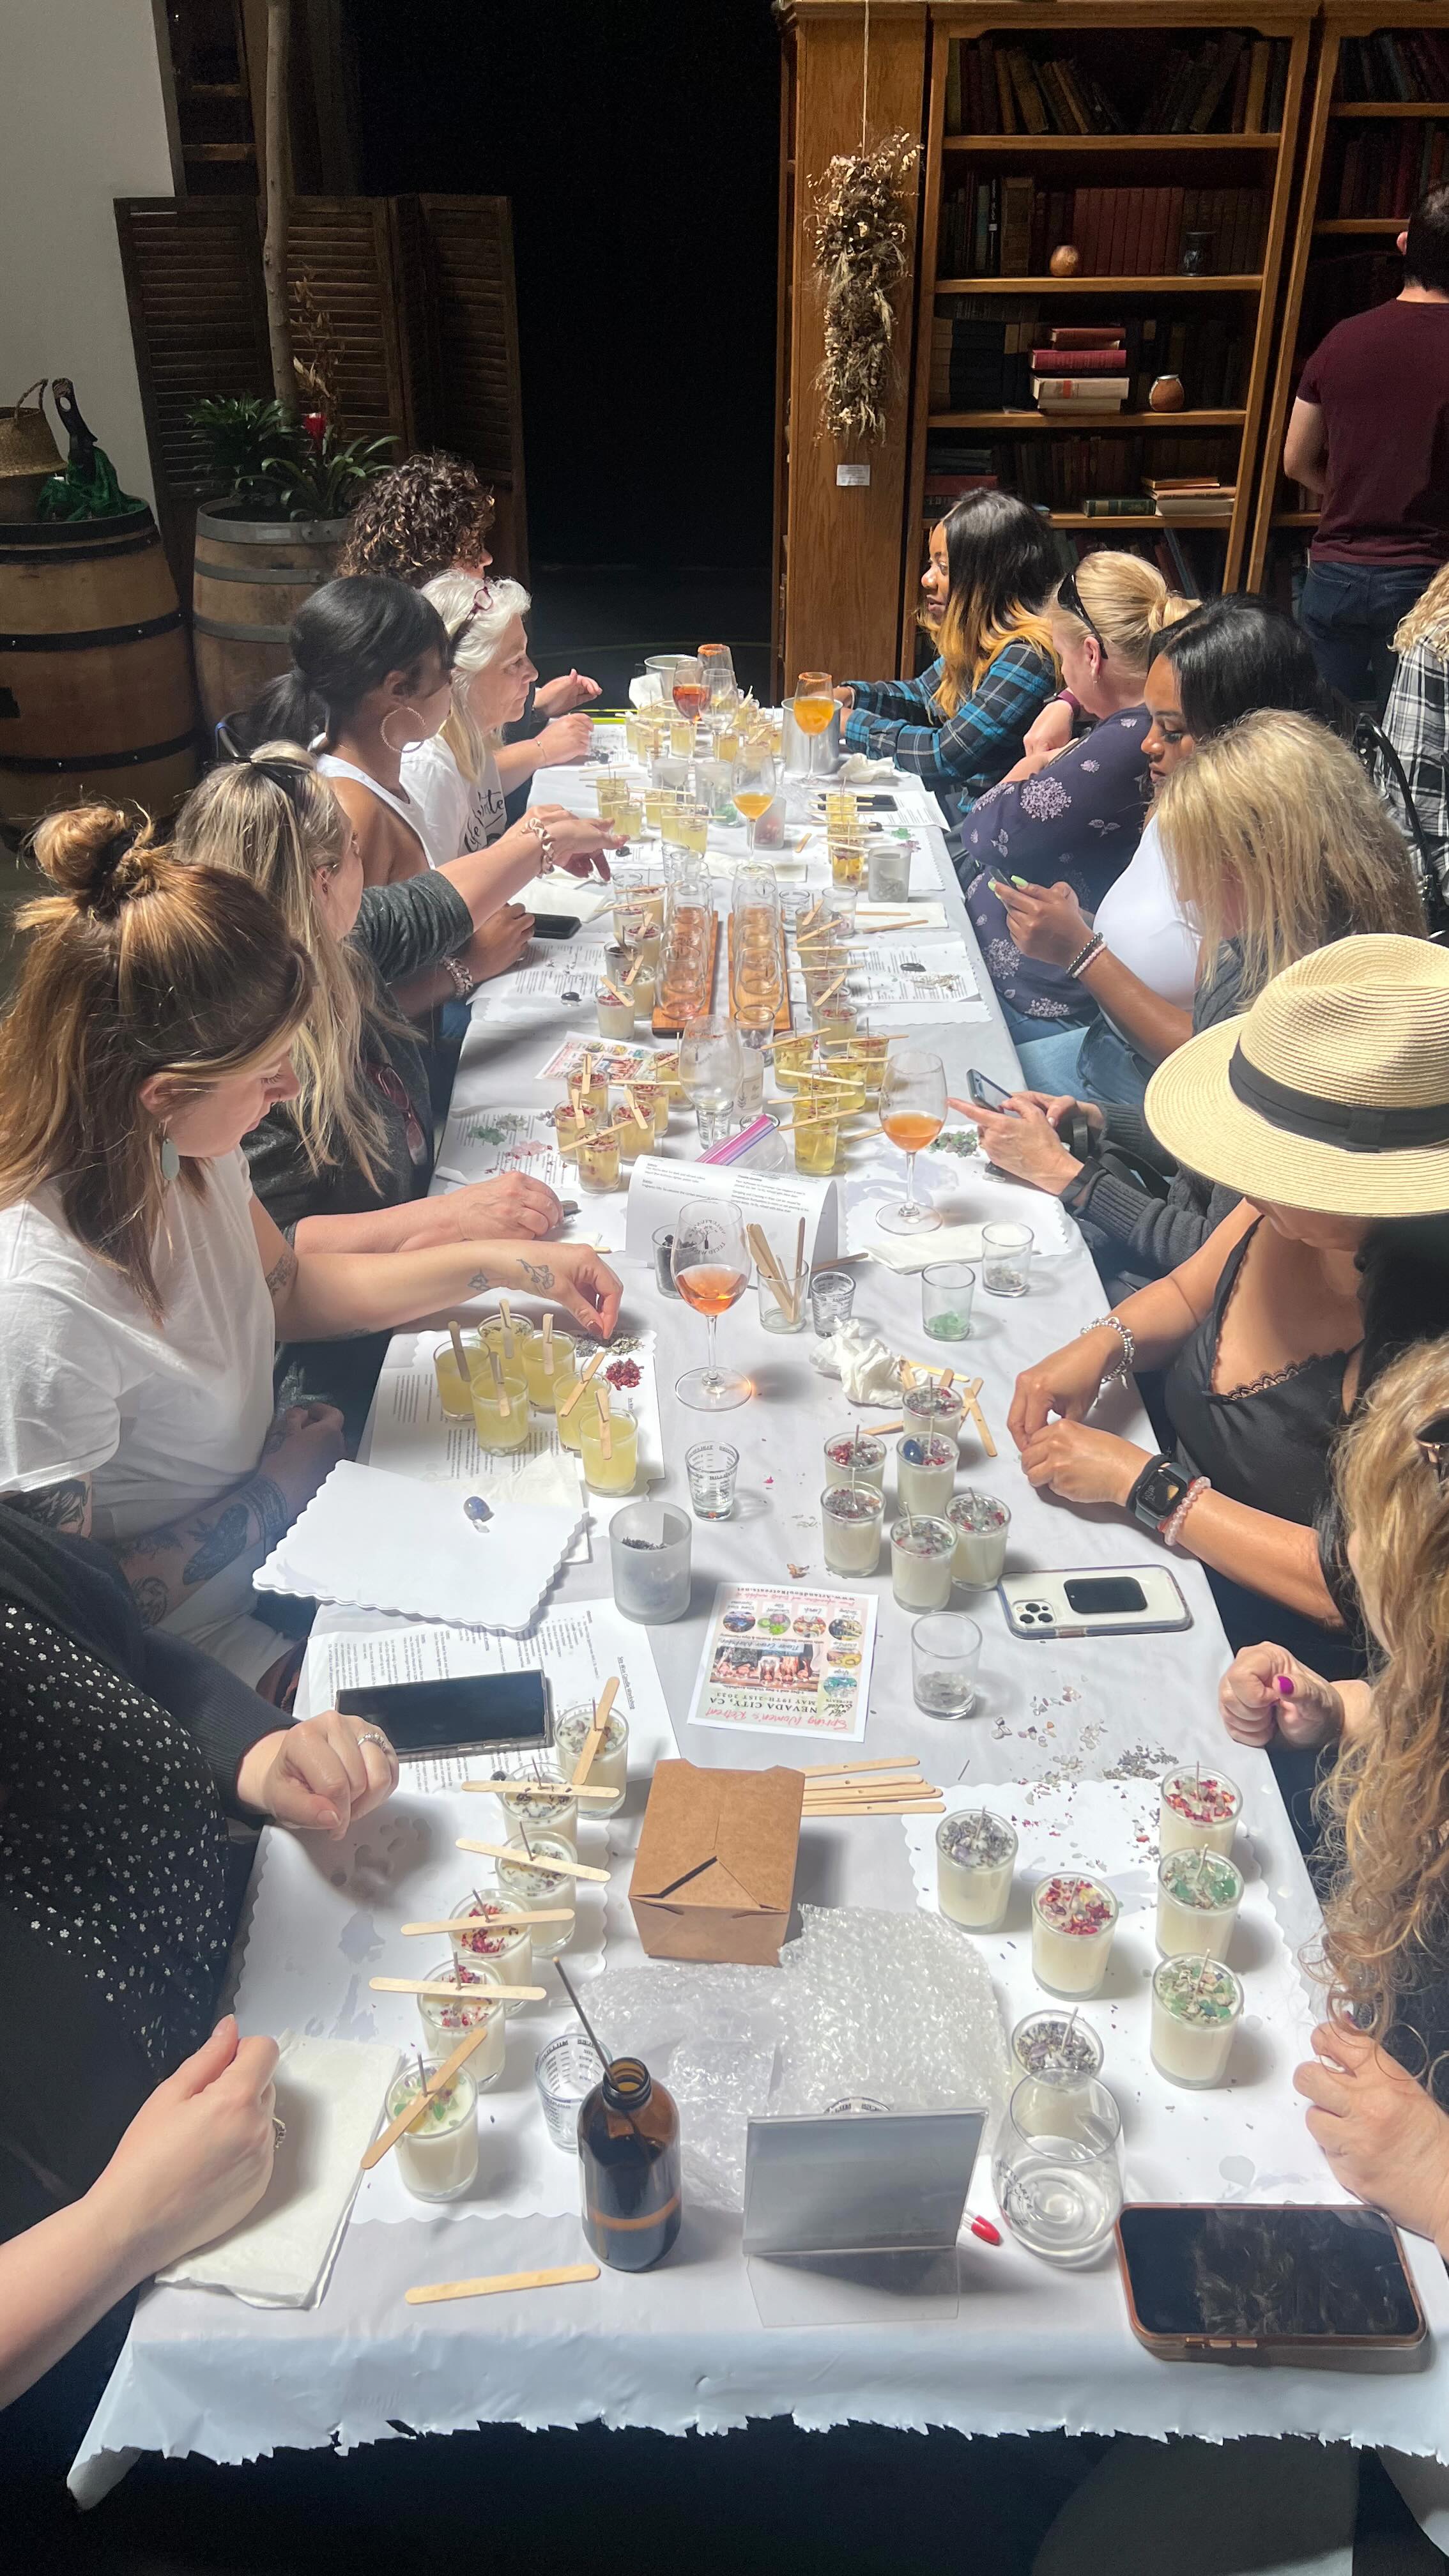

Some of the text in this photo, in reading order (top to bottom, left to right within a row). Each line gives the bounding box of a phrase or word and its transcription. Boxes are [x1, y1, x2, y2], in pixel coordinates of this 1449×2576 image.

[730, 1698, 762, 1708] CITY,
[767, 1703, 818, 1713] NEVADA
[705, 1706, 848, 1730] Spring Women's Retreat
